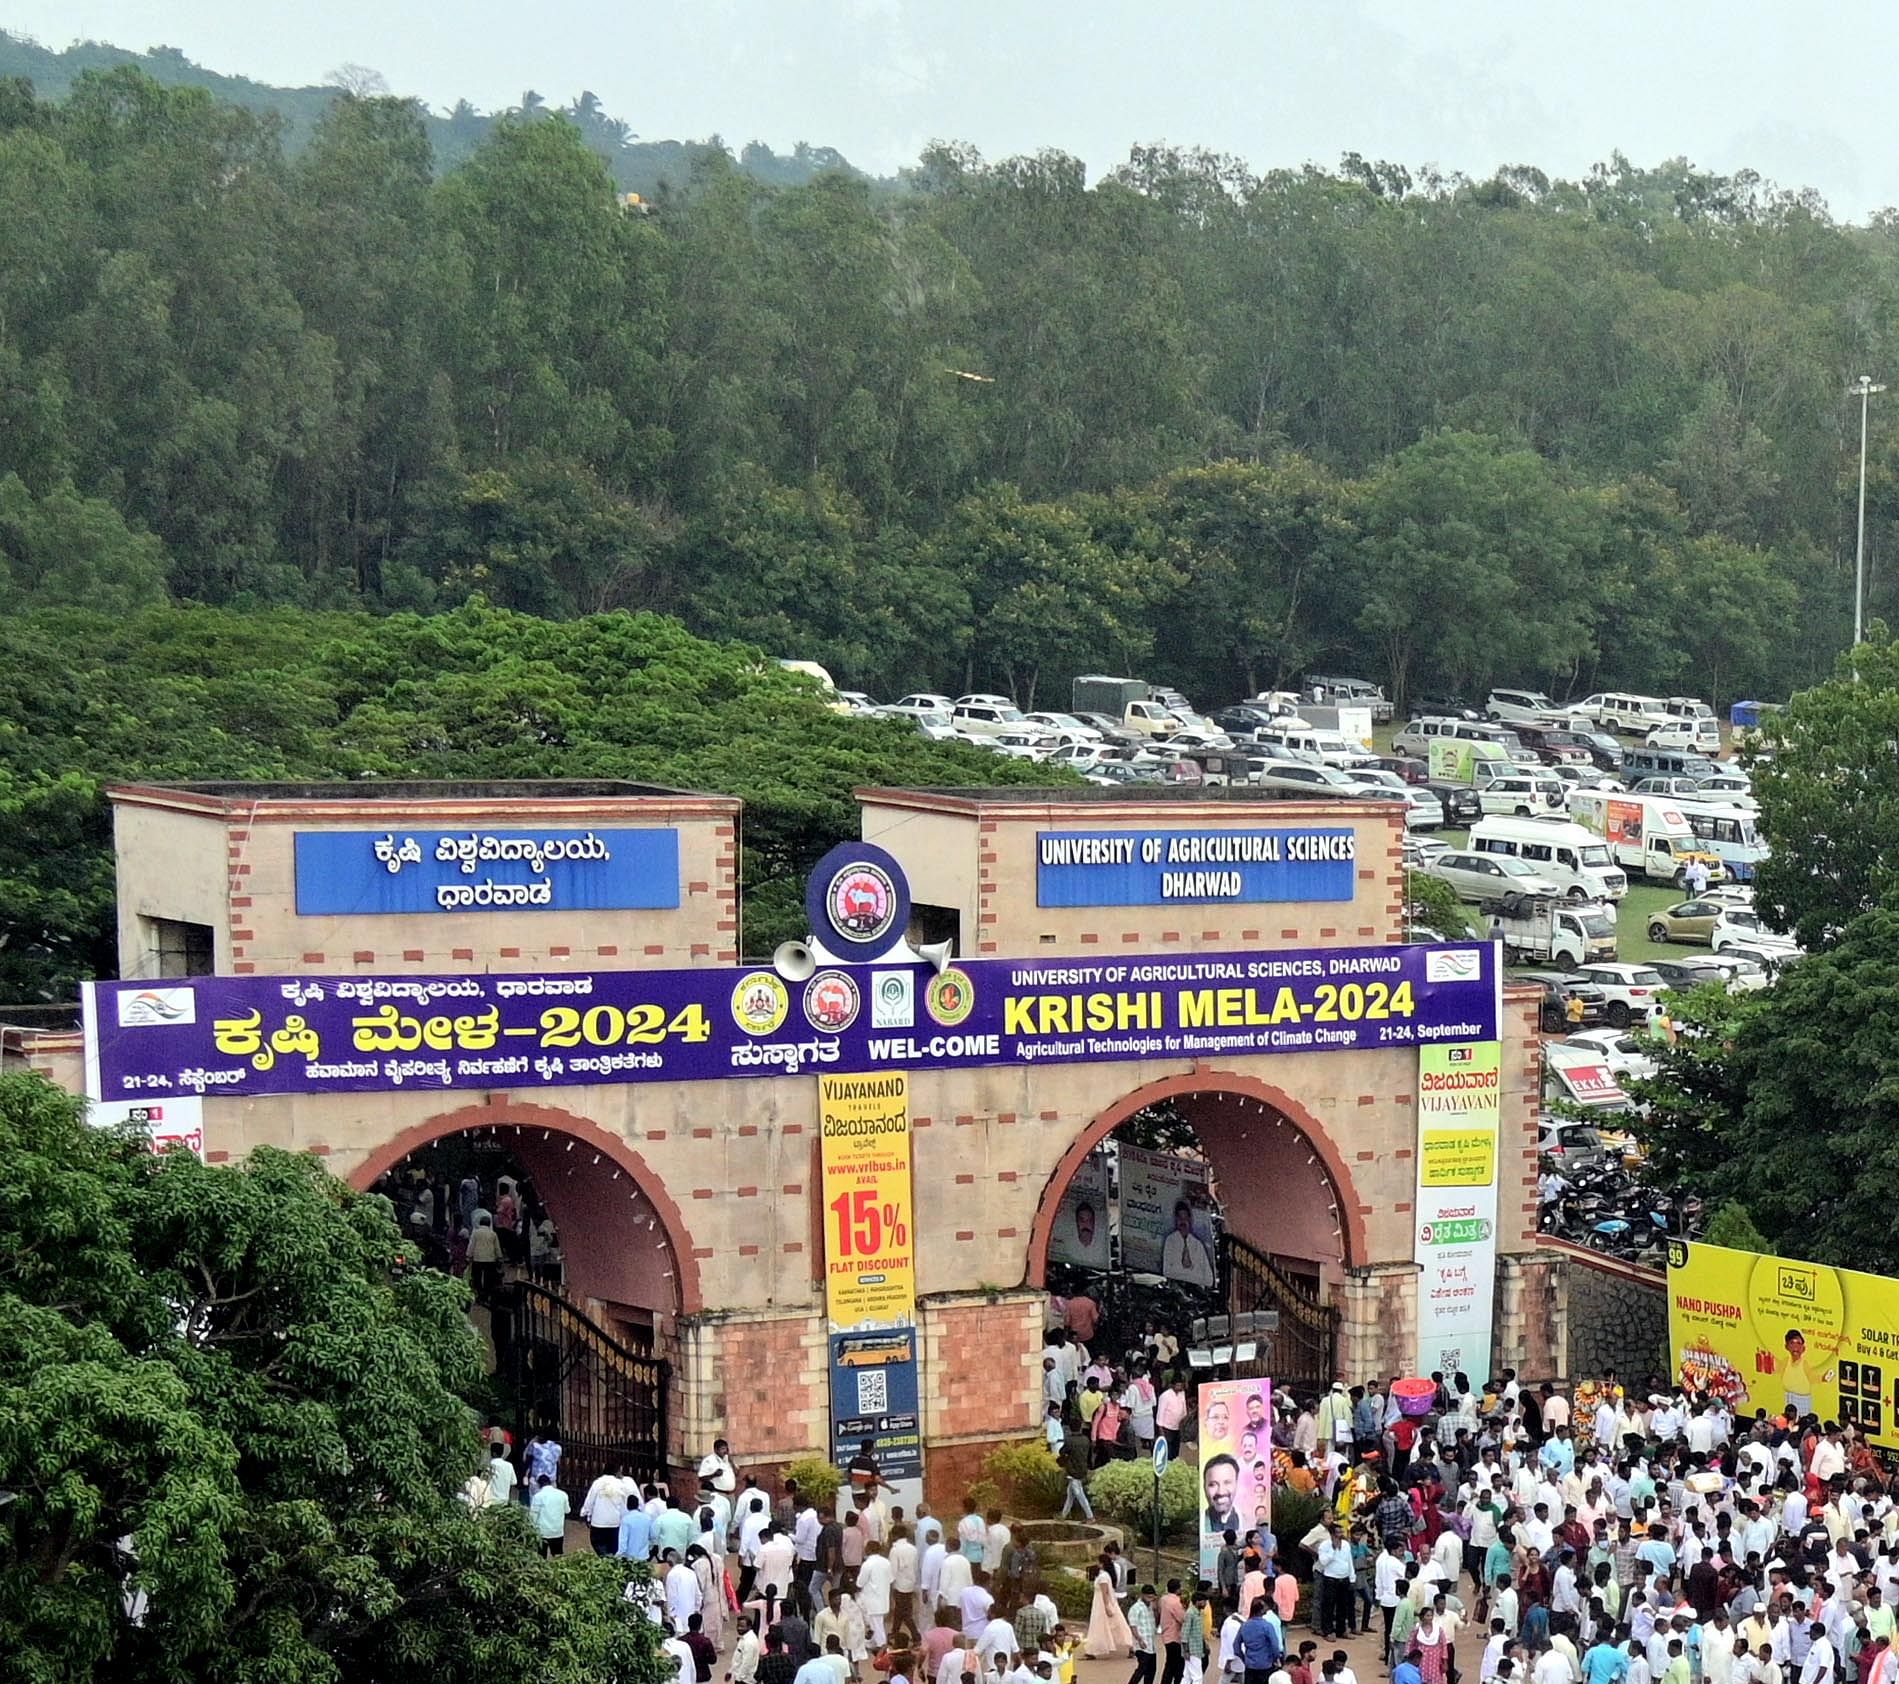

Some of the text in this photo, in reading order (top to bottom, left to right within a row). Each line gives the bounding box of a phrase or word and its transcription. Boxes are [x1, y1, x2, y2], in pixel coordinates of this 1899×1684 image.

[374, 834, 610, 877] ಕೃಷಿ ವಿಶ್ವವಿದ್ಯಾಲಯ,
[1040, 834, 1355, 865] UNIVERSITY OF AGRICULTURAL SCIENCES
[437, 880, 552, 910] ಧಾರವಾಡ
[1162, 871, 1241, 898] DHARWAD
[1012, 956, 1401, 986] UNIVERSITY OF AGRICULTURAL SCIENCES, DHARWAD
[281, 976, 593, 1006] ಕೃಷಿ ವಿಶ್ವವಿದ್ಯಾಲಯ, ಧಾರವಾಡ
[1004, 991, 1162, 1035] KRISHI
[1178, 980, 1415, 1028] MELA-2024
[213, 1007, 320, 1070] ಕೃಷಿ
[1016, 1028, 1357, 1060] Agricultural Technologies for Management of Climate Change
[1379, 1022, 1482, 1041] 21-24, September
[731, 1036, 840, 1072] ಸುಸ್ವಾಗತ
[868, 1034, 1000, 1060] WEL-COME
[306, 1060, 378, 1078] ಹವಾಮಾನ
[534, 1054, 564, 1080] ಕೃಷಿ
[1421, 1067, 1498, 1092] ವಿಜಯವಾಣಿ
[123, 1074, 172, 1089] 21-24,
[823, 1077, 904, 1101] VIJAYANAND
[1421, 1094, 1498, 1113] VIJAYAVANI
[824, 1106, 906, 1137] ವಿಜಯಾನಂದ
[827, 1158, 906, 1176] www.vrlbus.in
[830, 1190, 906, 1257] 15%
[830, 1257, 910, 1274] FLAT DISCOUNT
[1668, 1250, 1684, 1265] 99
[1704, 1300, 1742, 1320] PUSHPA
[1861, 1328, 1889, 1345] SOLAR
[1856, 1343, 1871, 1357] Buy
[1872, 1345, 1878, 1355] 4
[1886, 1348, 1899, 1361] Get
